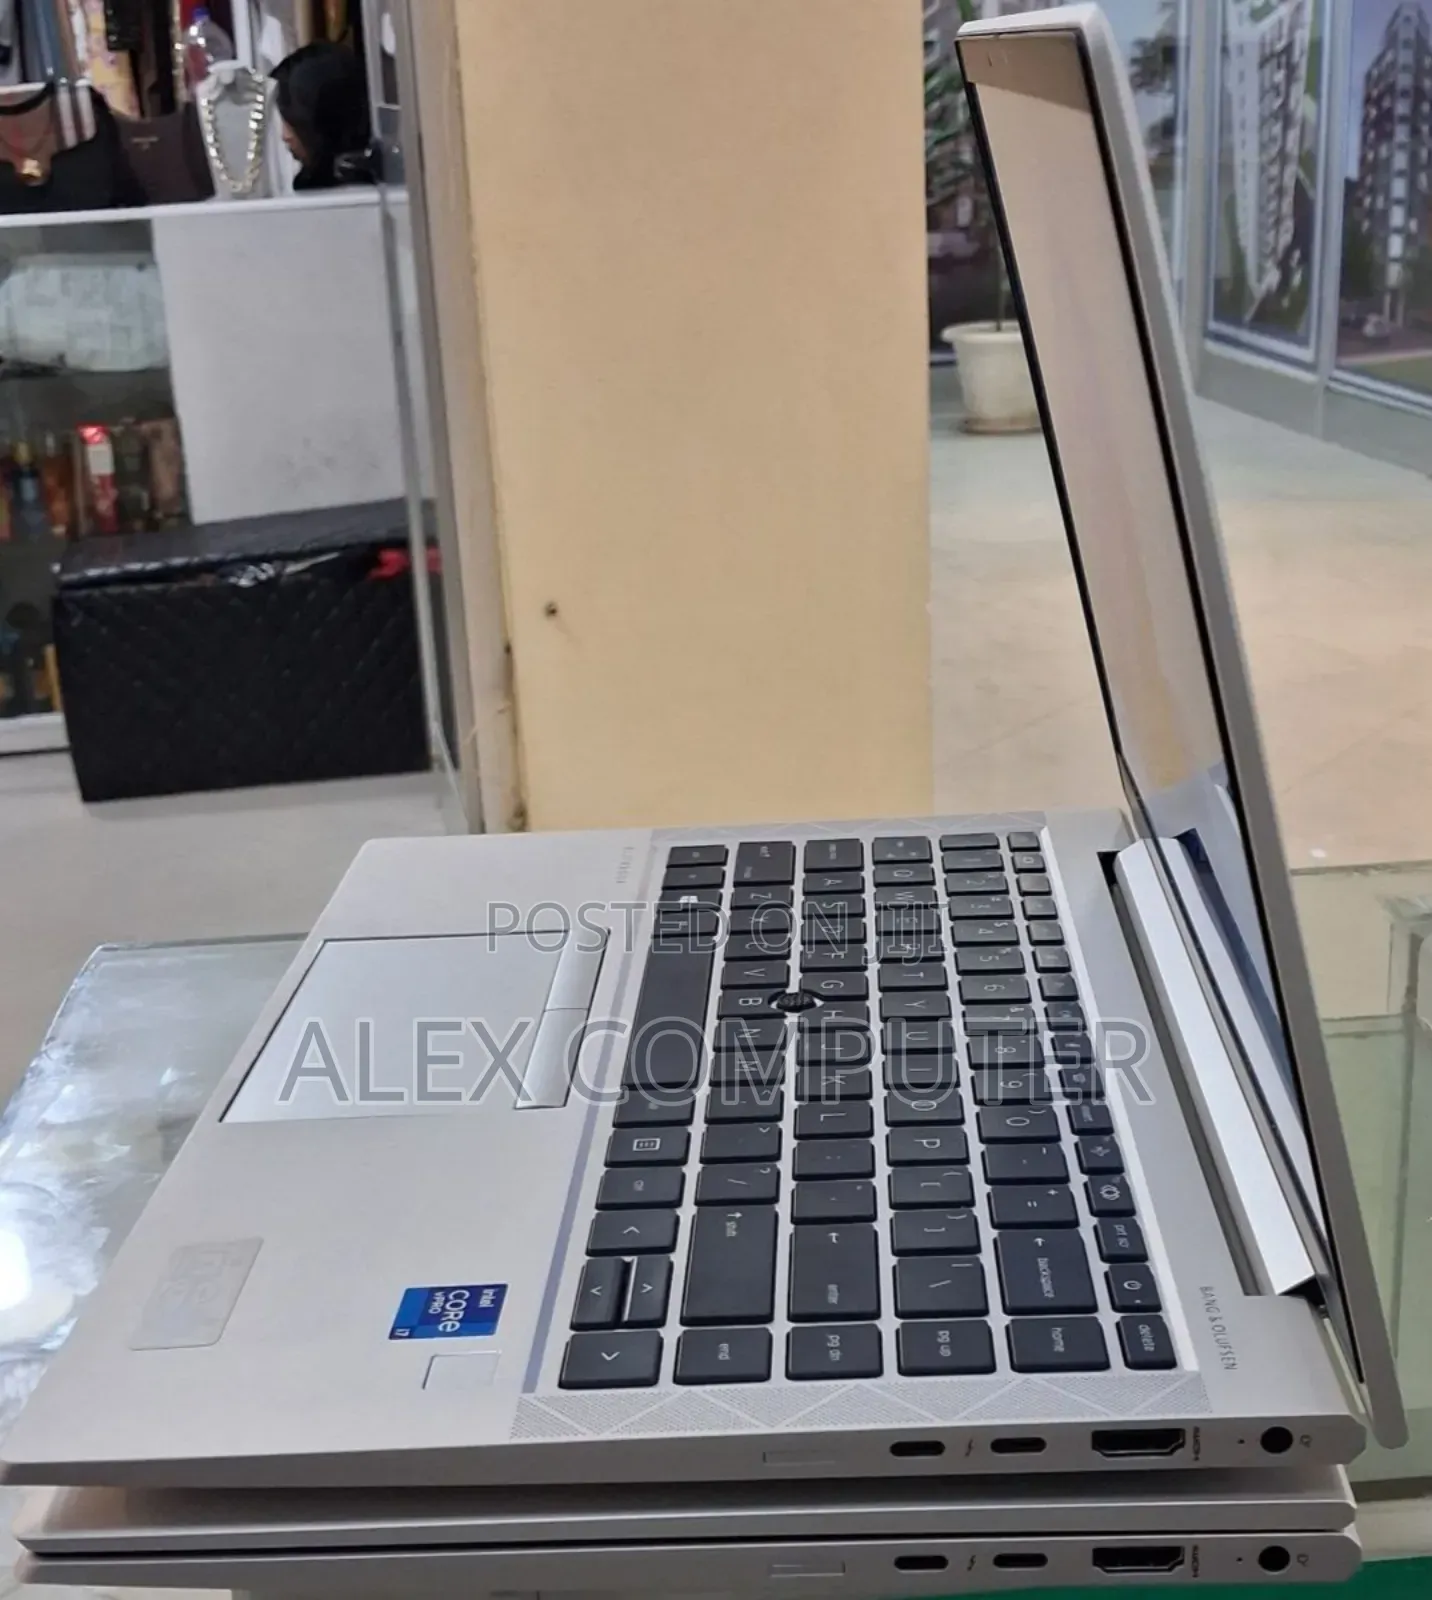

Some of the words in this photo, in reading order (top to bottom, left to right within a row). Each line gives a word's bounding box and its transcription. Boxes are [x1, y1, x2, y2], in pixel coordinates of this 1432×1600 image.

[823, 877, 844, 887] A
[750, 891, 773, 900] Z
[821, 951, 845, 960] F
[743, 967, 766, 977] V
[902, 970, 925, 979] T
[820, 979, 845, 989] G
[983, 983, 1006, 992] 6
[738, 997, 763, 1006] B
[904, 999, 927, 1009] Y
[822, 1009, 844, 1020] H
[737, 1028, 763, 1039] N
[905, 1030, 929, 1041] U
[994, 1045, 1018, 1054] 8
[734, 1060, 761, 1073] M
[820, 1075, 847, 1087] K
[999, 1079, 1024, 1089] 9
[911, 1099, 938, 1111] O
[820, 1111, 848, 1122] L
[914, 1137, 941, 1149] P
[478, 1288, 499, 1308] intel
[1199, 1286, 1221, 1313] BANG
[1211, 1324, 1238, 1371] OLUFSEN
[827, 1334, 841, 1347] pg
[937, 1330, 950, 1343] pg
[1051, 1327, 1065, 1352] home
[1138, 1324, 1156, 1352] delete
[718, 1343, 730, 1361] end
[940, 1345, 951, 1357] up
